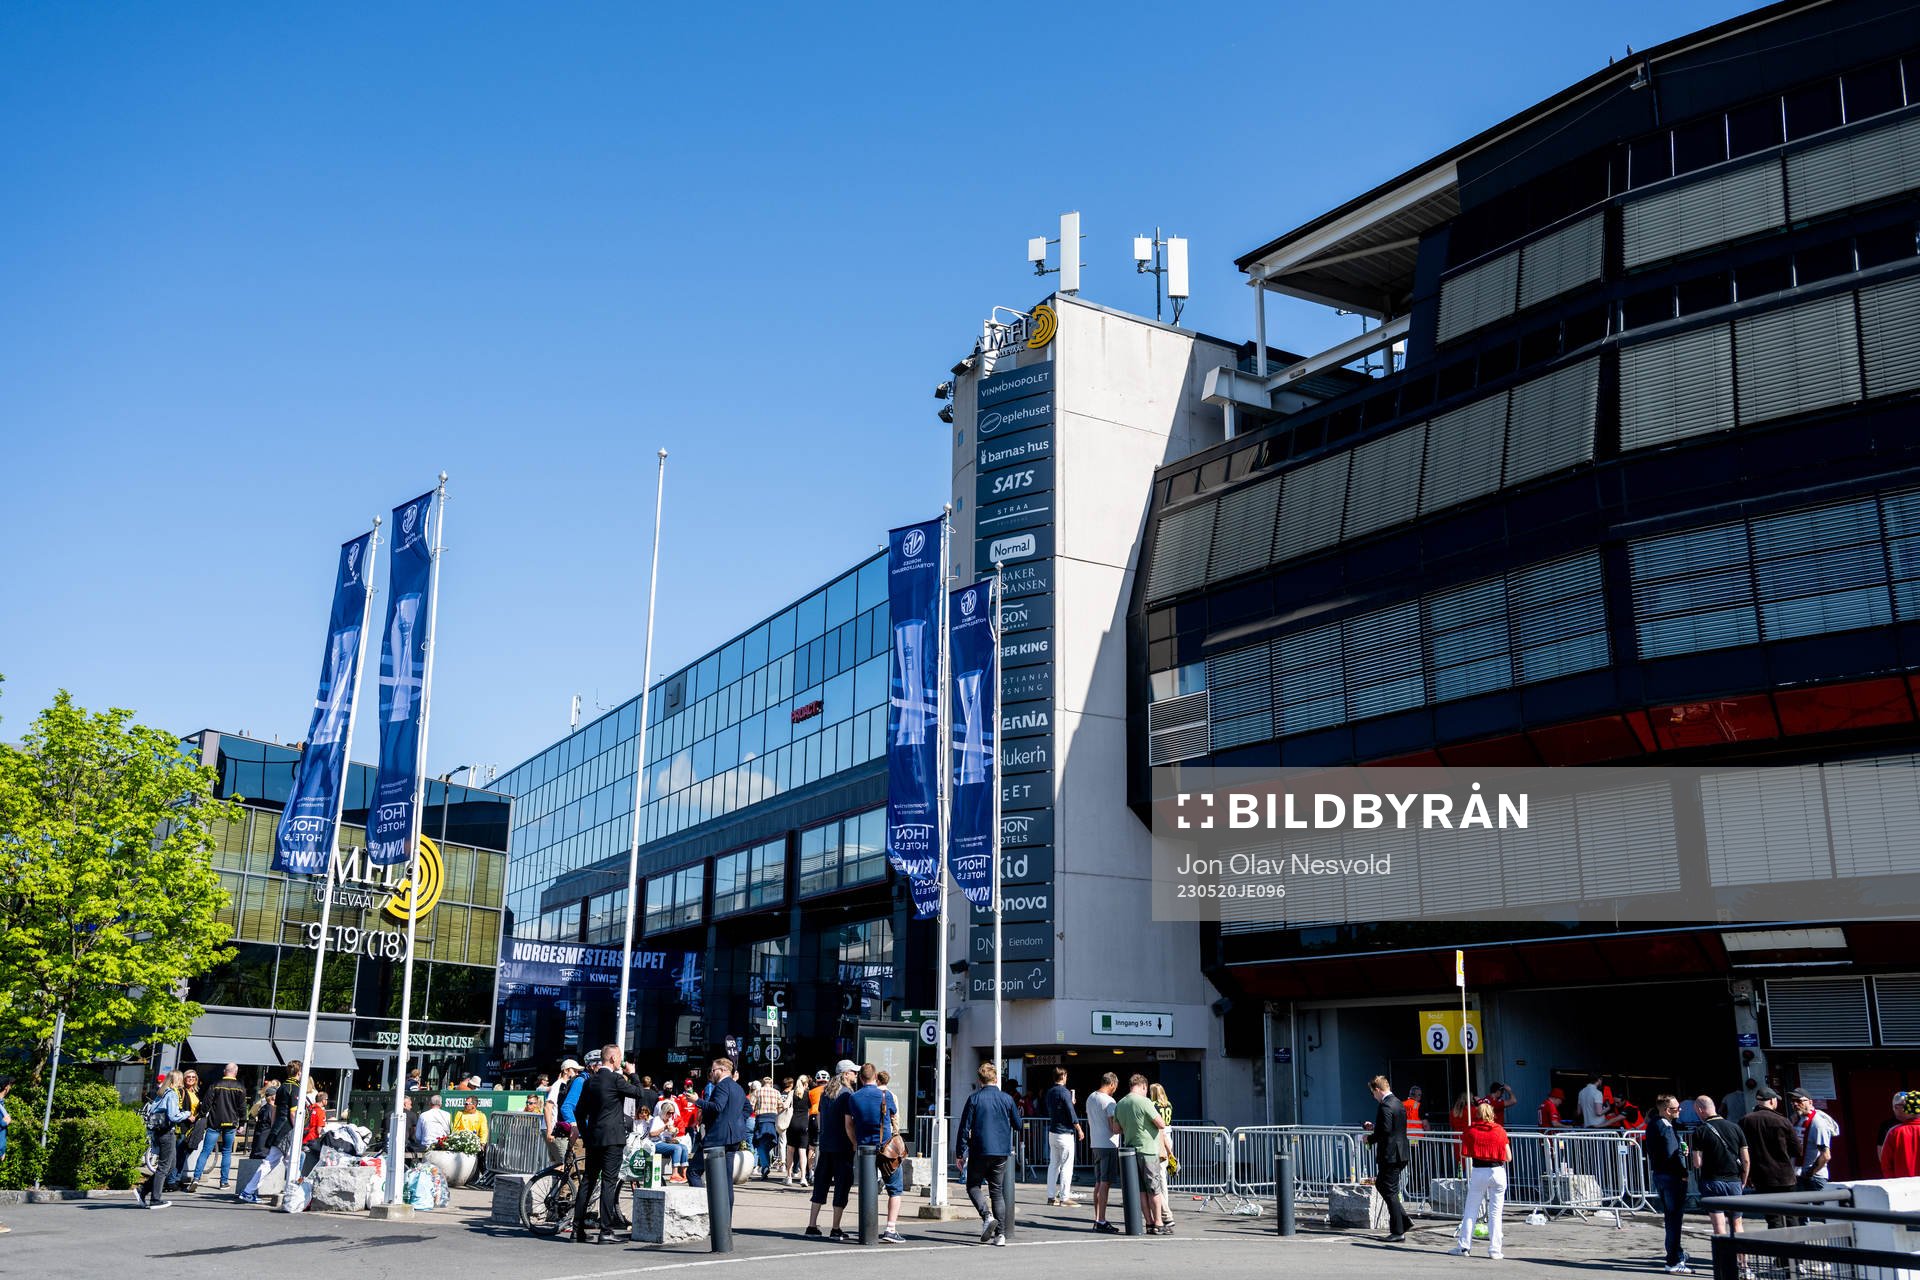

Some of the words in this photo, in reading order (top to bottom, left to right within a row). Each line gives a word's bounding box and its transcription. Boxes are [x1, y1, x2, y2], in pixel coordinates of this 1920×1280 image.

[972, 318, 1028, 353] AMFI
[981, 373, 1049, 397] VINMONOPOLET
[1003, 404, 1050, 424] eplehuset
[988, 446, 1025, 462] barnas
[1027, 440, 1049, 453] hus
[992, 469, 1035, 494] SATS
[997, 503, 1029, 515] STRAA
[994, 538, 1030, 557] Normal
[1001, 567, 1035, 582] BAKER
[1020, 641, 1048, 654] KING
[1001, 710, 1049, 731] ERNIA
[1002, 785, 1031, 801] EET
[1001, 818, 1030, 833] HON
[1001, 834, 1028, 844] OTELS
[318, 845, 394, 887] MFI
[315, 889, 379, 910] ULEVAAL
[308, 922, 359, 954] 9-19
[367, 930, 409, 963] (18)
[977, 932, 996, 955] DN
[1009, 938, 1043, 946] Eiendom
[590, 973, 609, 983] KIWI
[974, 977, 1024, 993] Dr.Dopin
[773, 991, 785, 1008] C
[1115, 1019, 1139, 1027] Inngang
[436, 1035, 475, 1048] HOUSE
[926, 1026, 937, 1043] 9
[1433, 1031, 1444, 1051] 8
[1160, 1107, 1172, 1126] 18
